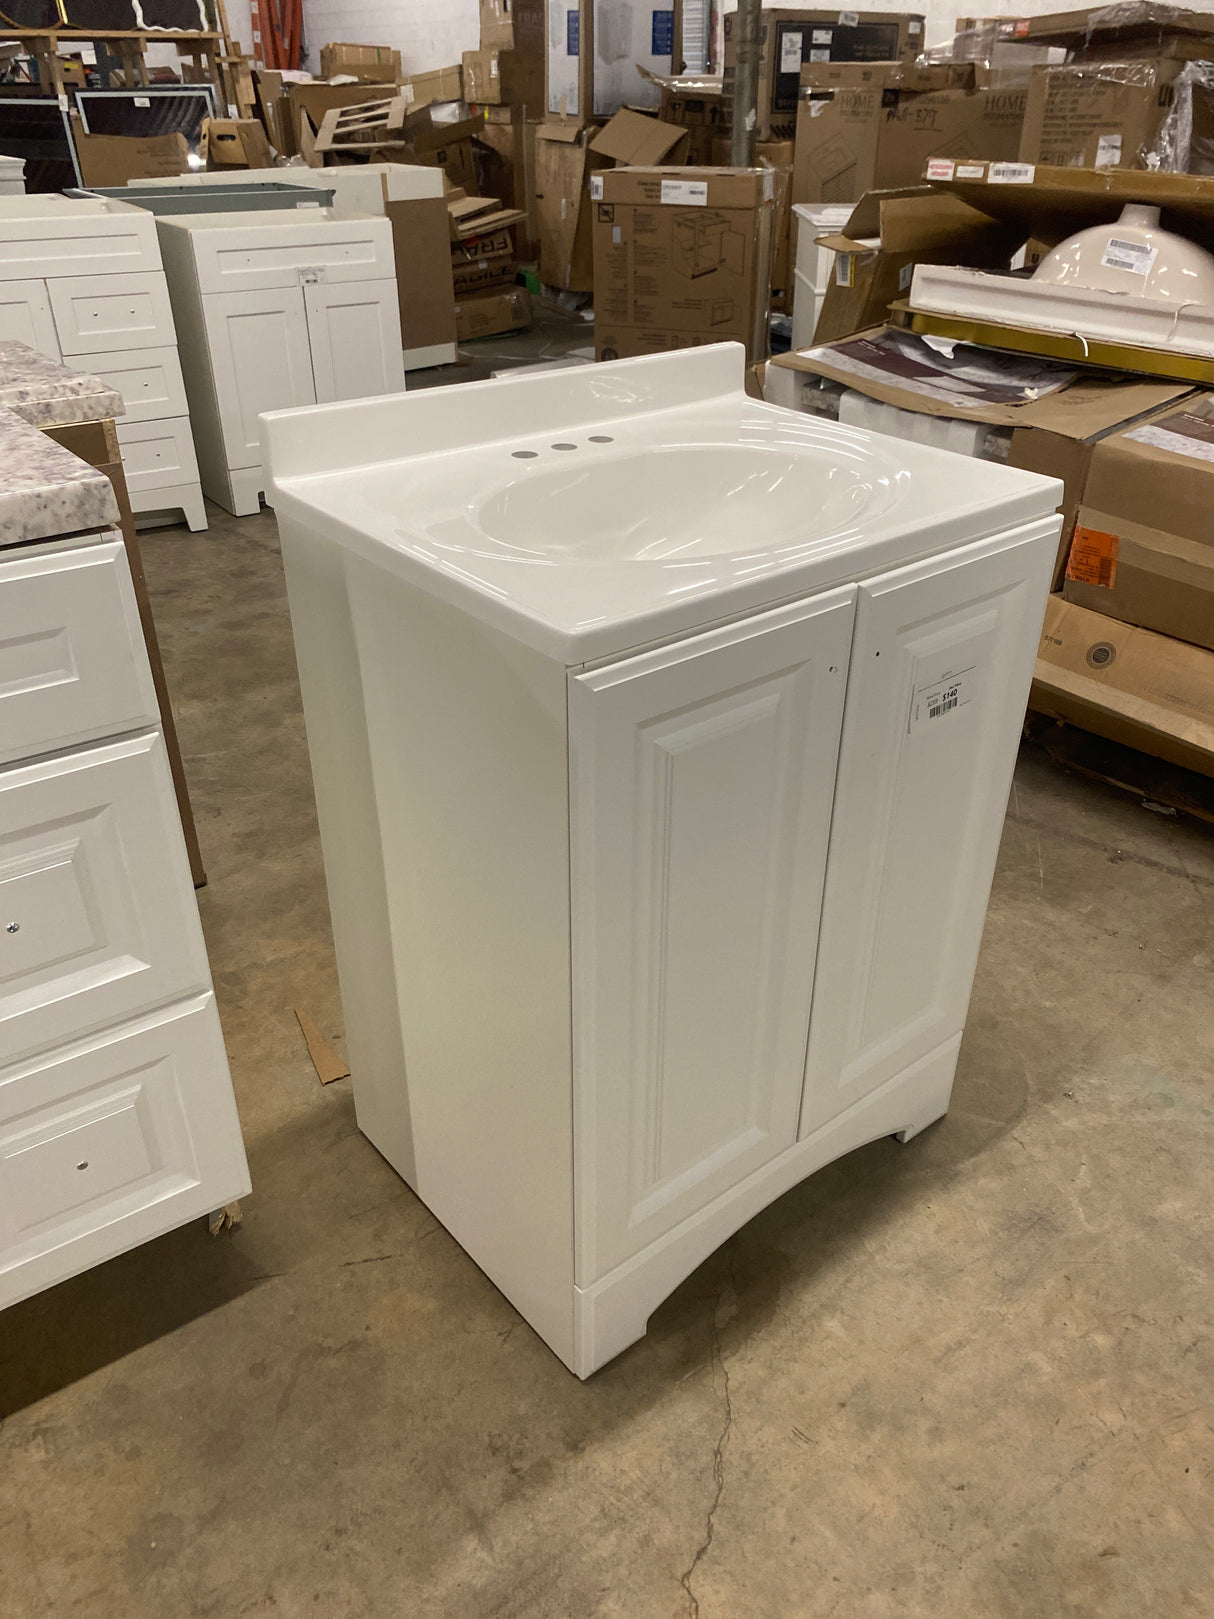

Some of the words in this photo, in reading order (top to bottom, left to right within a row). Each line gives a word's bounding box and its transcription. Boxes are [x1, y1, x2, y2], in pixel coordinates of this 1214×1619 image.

[840, 95, 874, 110] HOME
[984, 95, 1029, 111] HOME
[942, 688, 958, 702] $140
